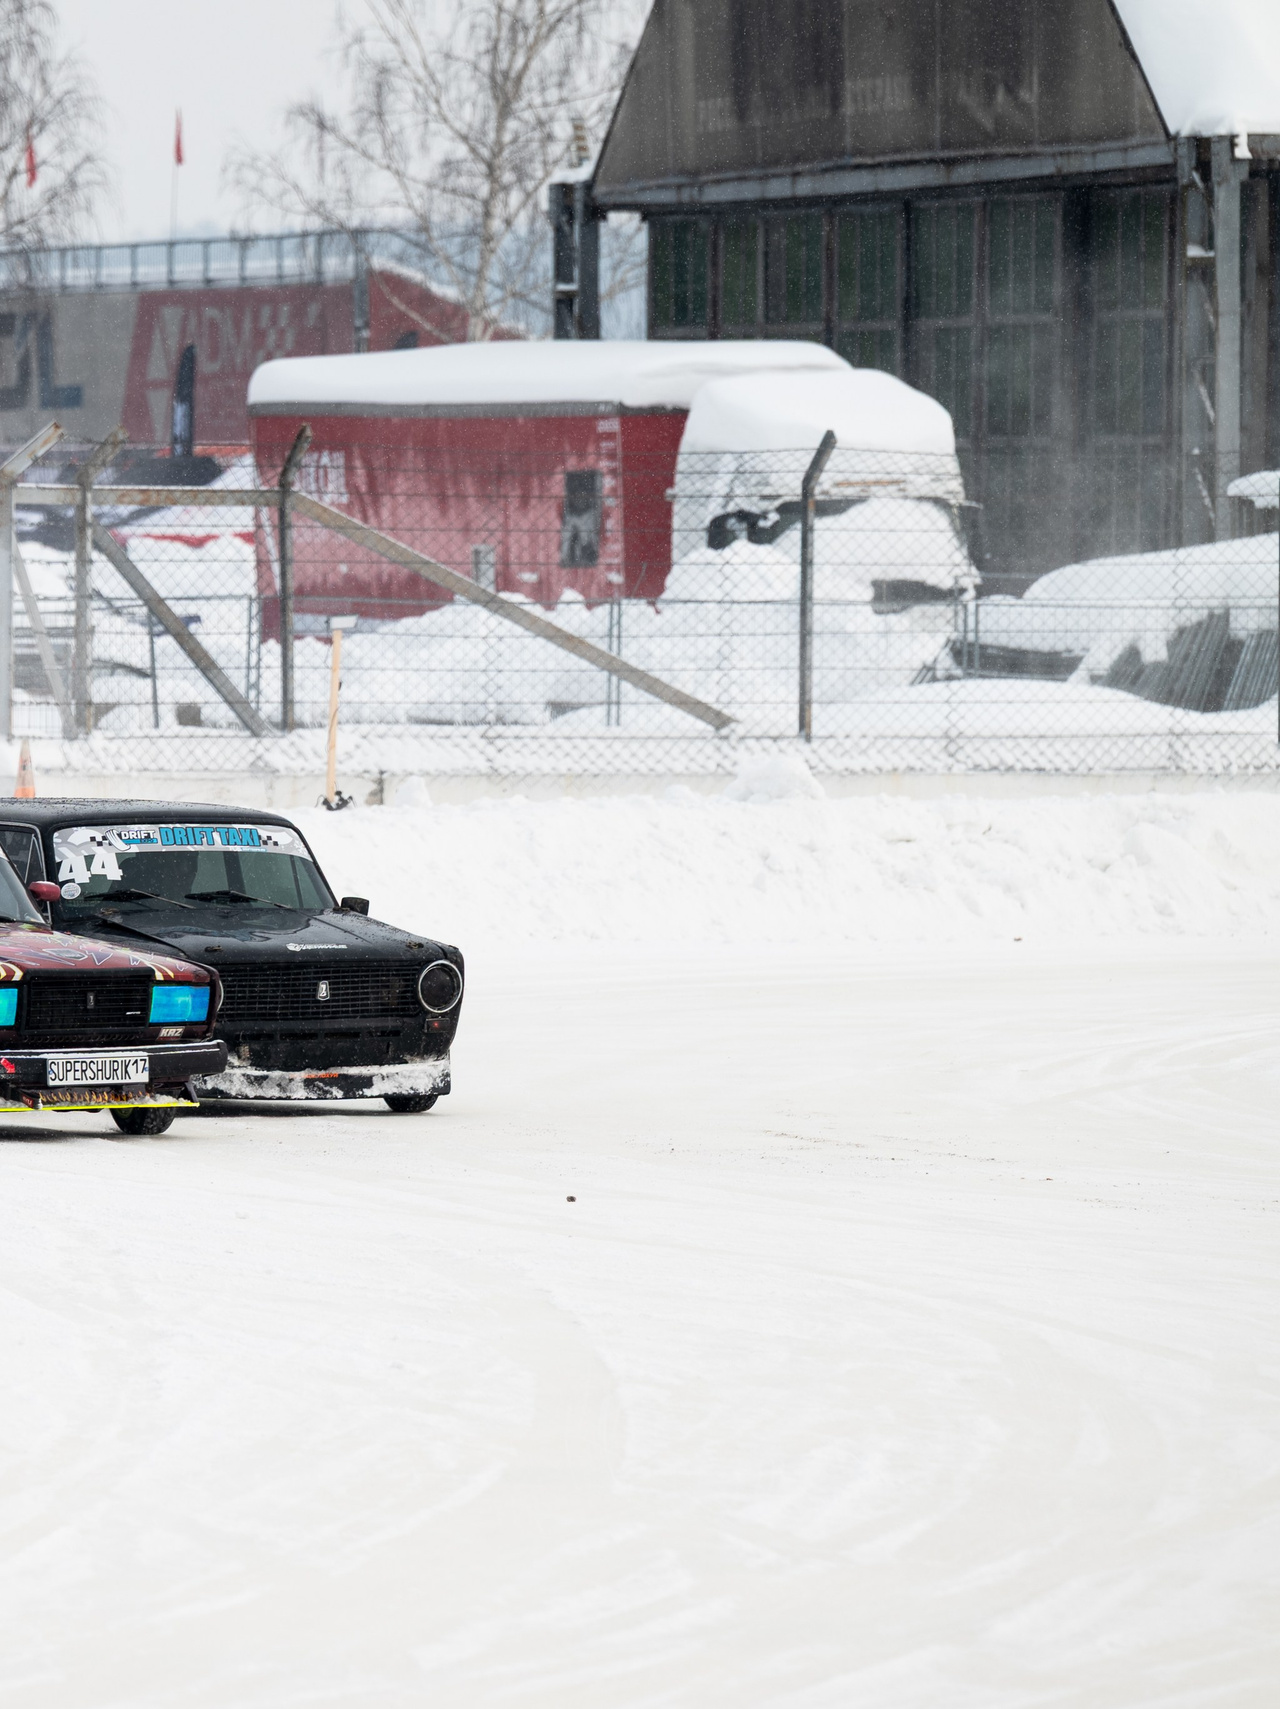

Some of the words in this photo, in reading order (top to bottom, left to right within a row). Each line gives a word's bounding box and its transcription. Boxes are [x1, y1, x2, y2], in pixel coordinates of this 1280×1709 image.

[121, 830, 156, 840] DRIFT
[160, 827, 218, 846] DRIFT
[218, 827, 261, 847] TAXI
[58, 853, 123, 883] 44
